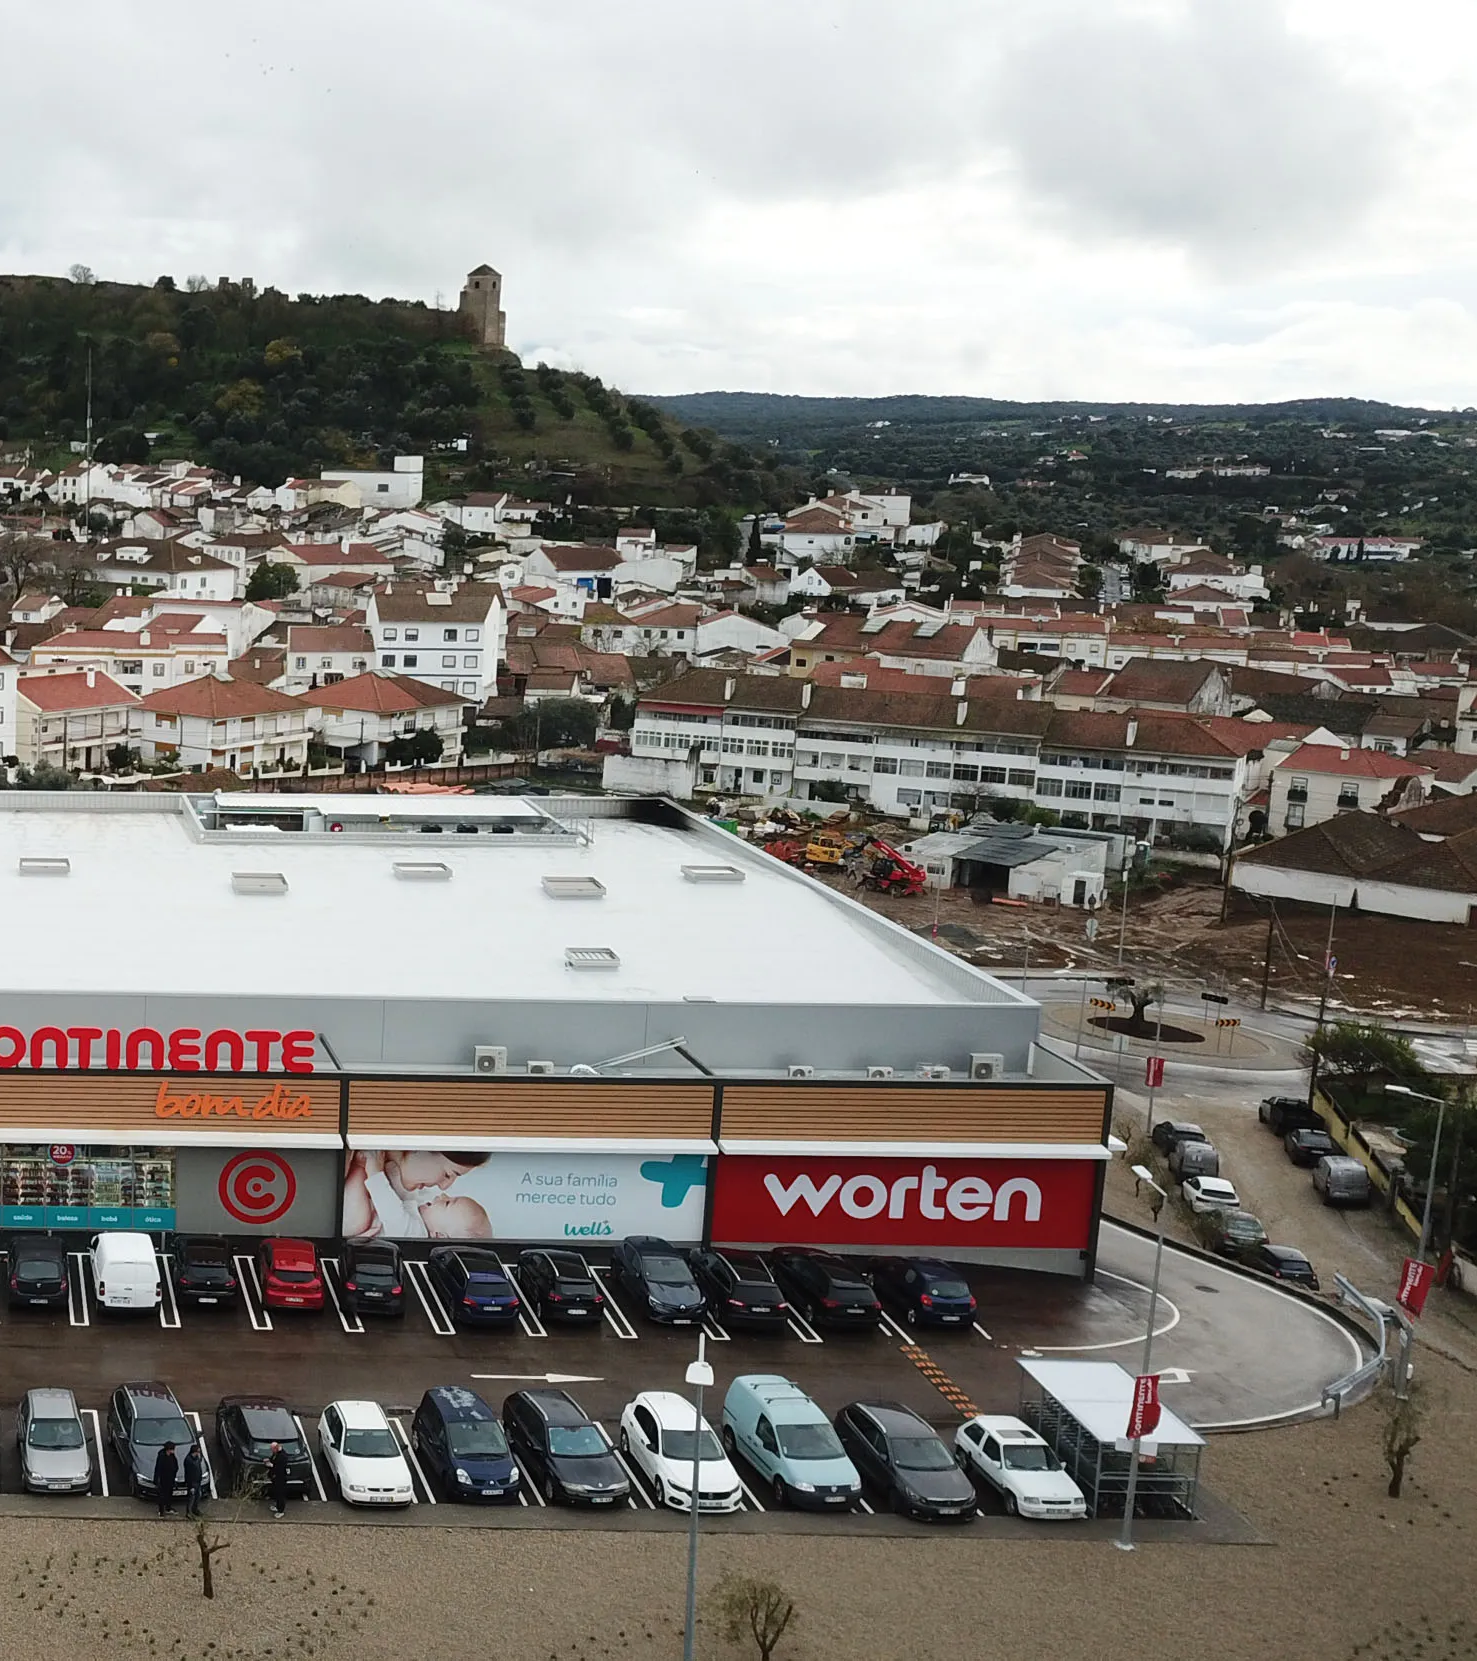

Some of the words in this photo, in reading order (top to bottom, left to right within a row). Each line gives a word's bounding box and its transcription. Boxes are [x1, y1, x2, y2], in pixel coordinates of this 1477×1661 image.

[155, 1081, 244, 1118] bom
[253, 1083, 313, 1119] dia
[521, 1172, 533, 1185] A
[535, 1175, 563, 1186] sua
[566, 1172, 618, 1188] família
[763, 1165, 1042, 1222] worten
[515, 1192, 576, 1205] merece
[579, 1193, 617, 1206] tudo
